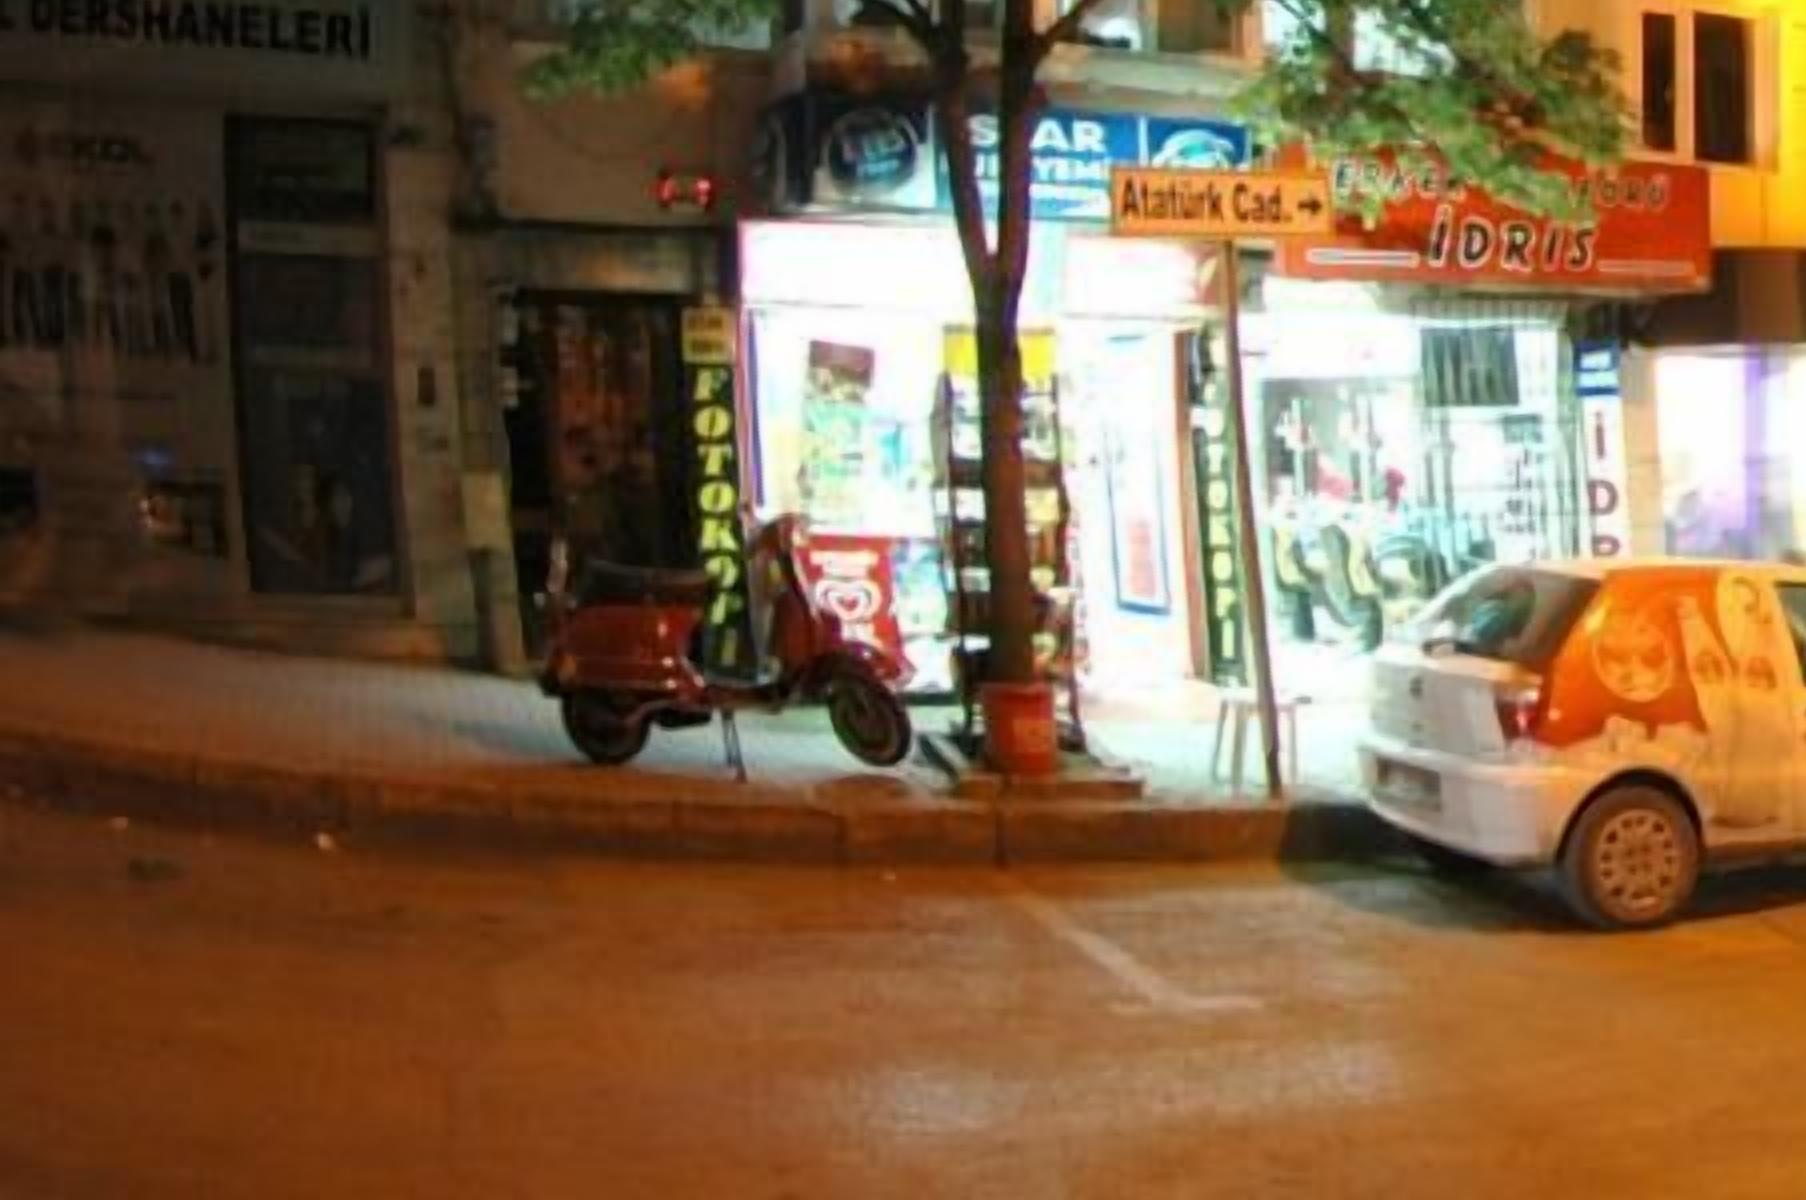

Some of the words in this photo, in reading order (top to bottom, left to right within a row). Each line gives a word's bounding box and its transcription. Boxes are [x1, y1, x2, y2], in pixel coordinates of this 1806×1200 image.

[966, 113, 1108, 153] SAR
[1121, 178, 1225, 223] Atatürk
[1233, 182, 1294, 224] Cad.
